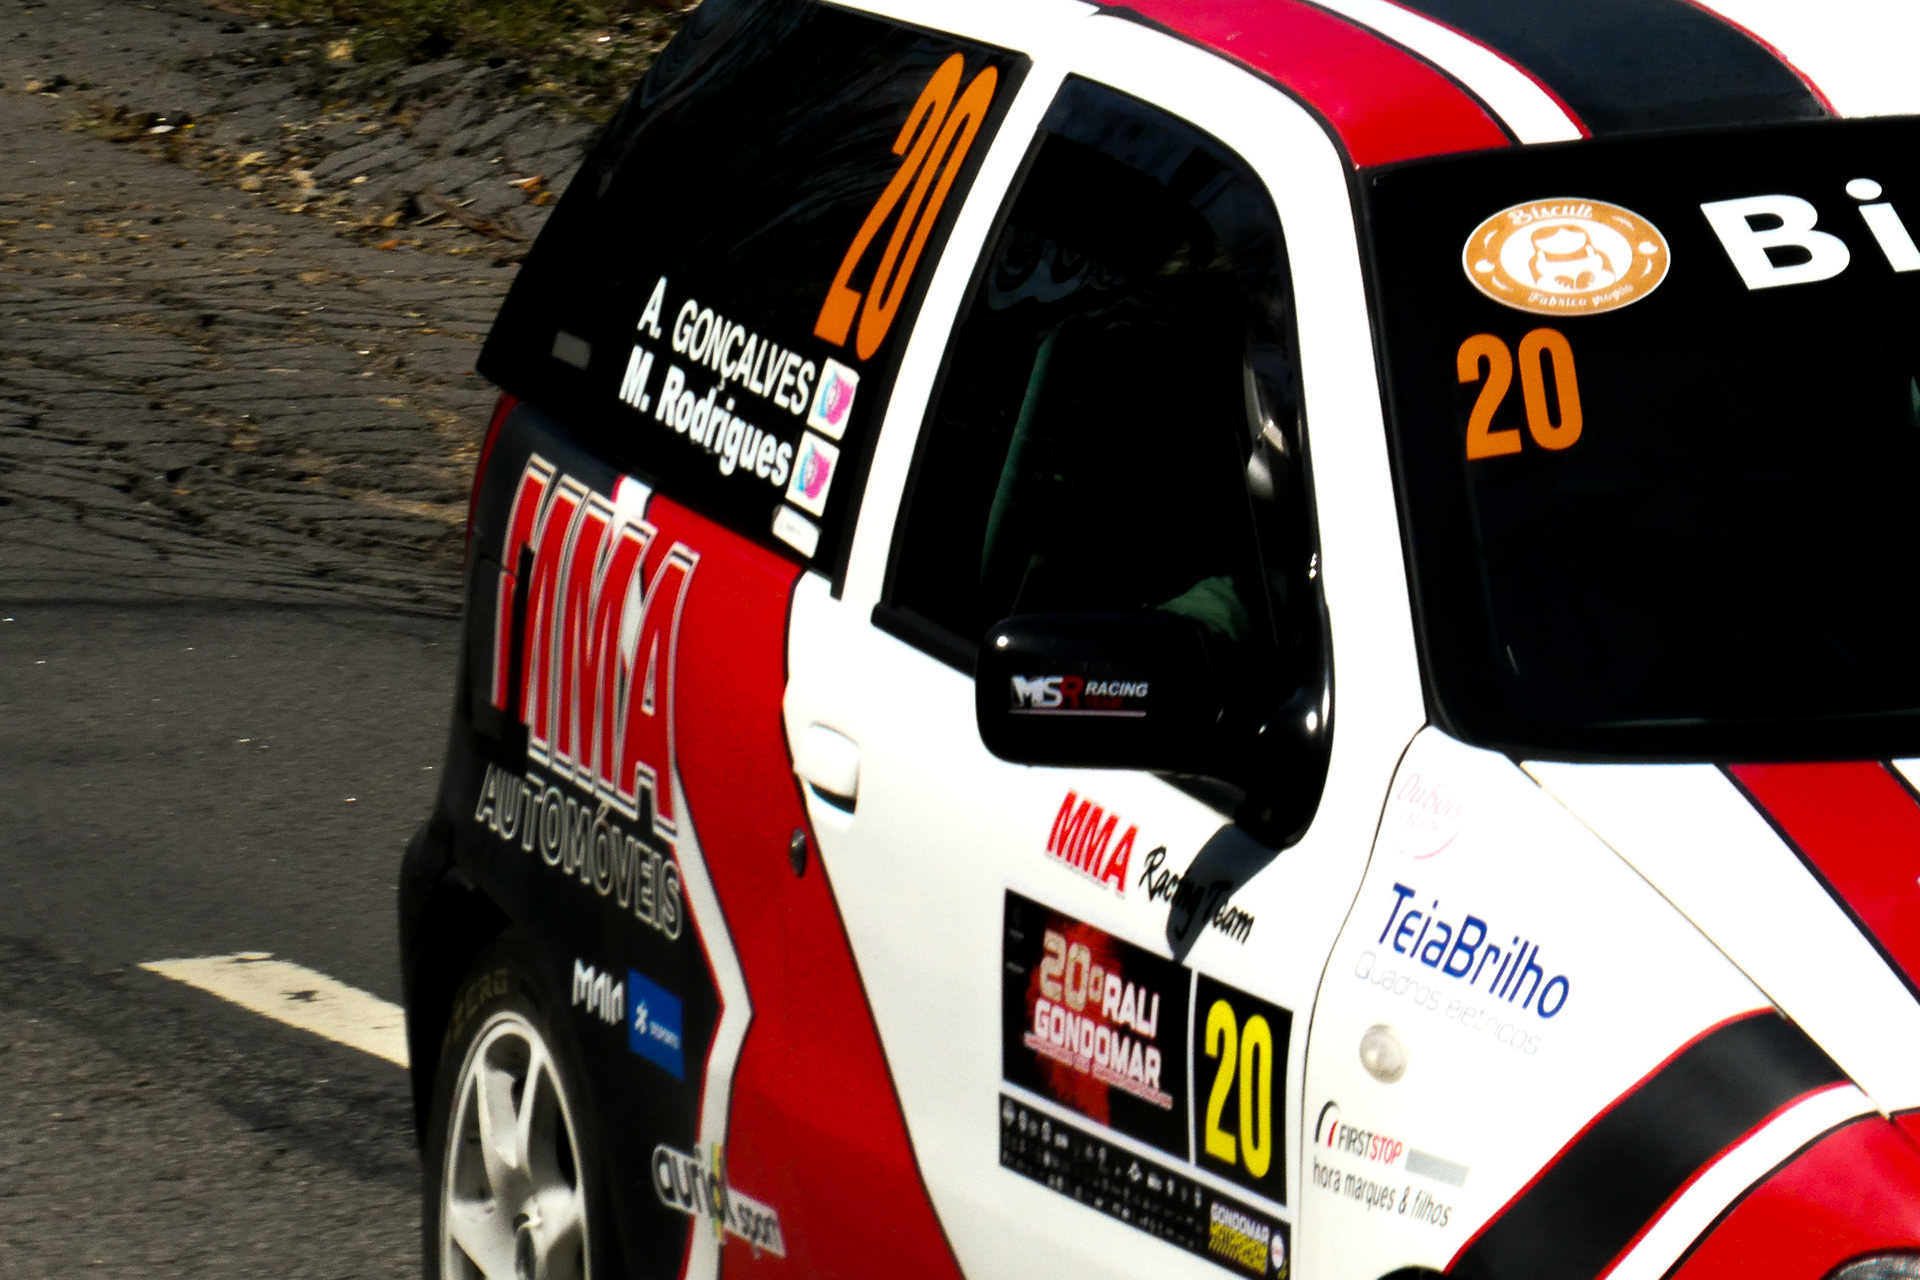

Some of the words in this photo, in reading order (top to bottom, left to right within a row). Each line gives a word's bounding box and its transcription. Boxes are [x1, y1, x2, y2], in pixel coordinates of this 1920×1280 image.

[813, 52, 998, 361] 20
[637, 276, 668, 340] A.
[672, 298, 815, 415] GONÇALVES
[1456, 327, 1583, 461] 20
[618, 345, 655, 414] M.
[656, 364, 793, 487] Rodrigues
[491, 453, 700, 843] MMA
[1011, 675, 1084, 708] MSR
[1084, 679, 1149, 698] RACING
[474, 762, 683, 941] AUTOMÓVEIS
[1045, 788, 1140, 897] MMA
[1138, 845, 1204, 942] Racing
[1200, 879, 1255, 945] Team
[1102, 973, 1160, 1038] RALI
[1354, 950, 1443, 1012] Quadros
[1378, 881, 1570, 1020] TeiaBrilho
[1034, 998, 1162, 1091] GONDOMAR
[1205, 1000, 1272, 1178] 20
[1313, 1155, 1341, 1196] hora
[1344, 1170, 1397, 1214] marques
[1397, 1185, 1412, 1214] &
[1412, 1189, 1453, 1229] filhos
